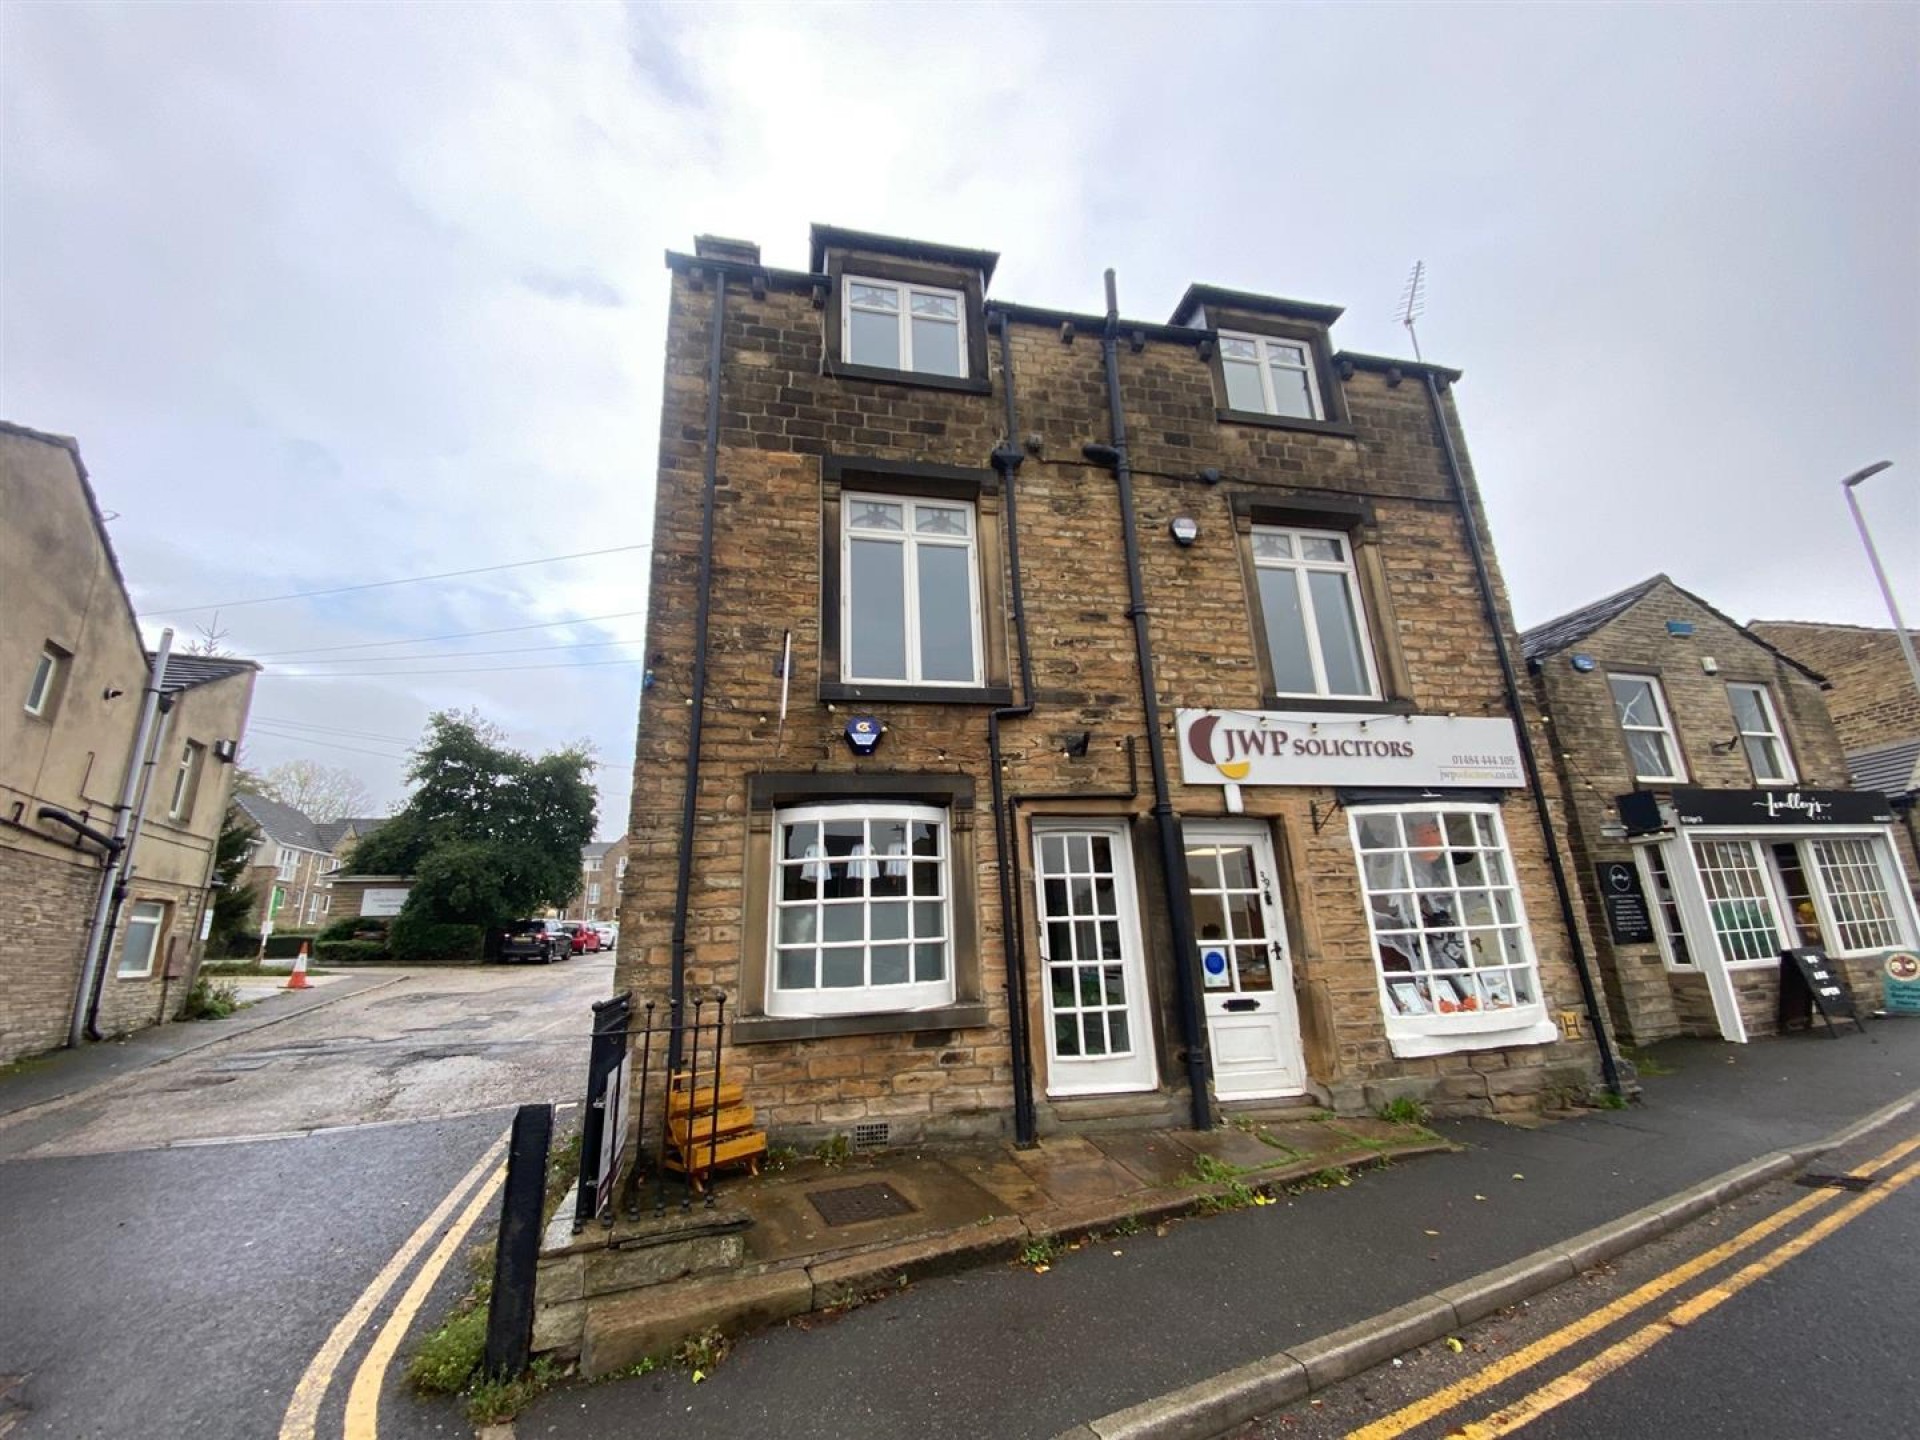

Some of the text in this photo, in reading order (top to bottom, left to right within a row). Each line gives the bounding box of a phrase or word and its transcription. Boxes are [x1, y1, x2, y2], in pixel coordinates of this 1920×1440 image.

[1223, 729, 1414, 762] JWP SOLICITORS
[1452, 755, 1479, 765] 01484
[1481, 755, 1497, 765] 444
